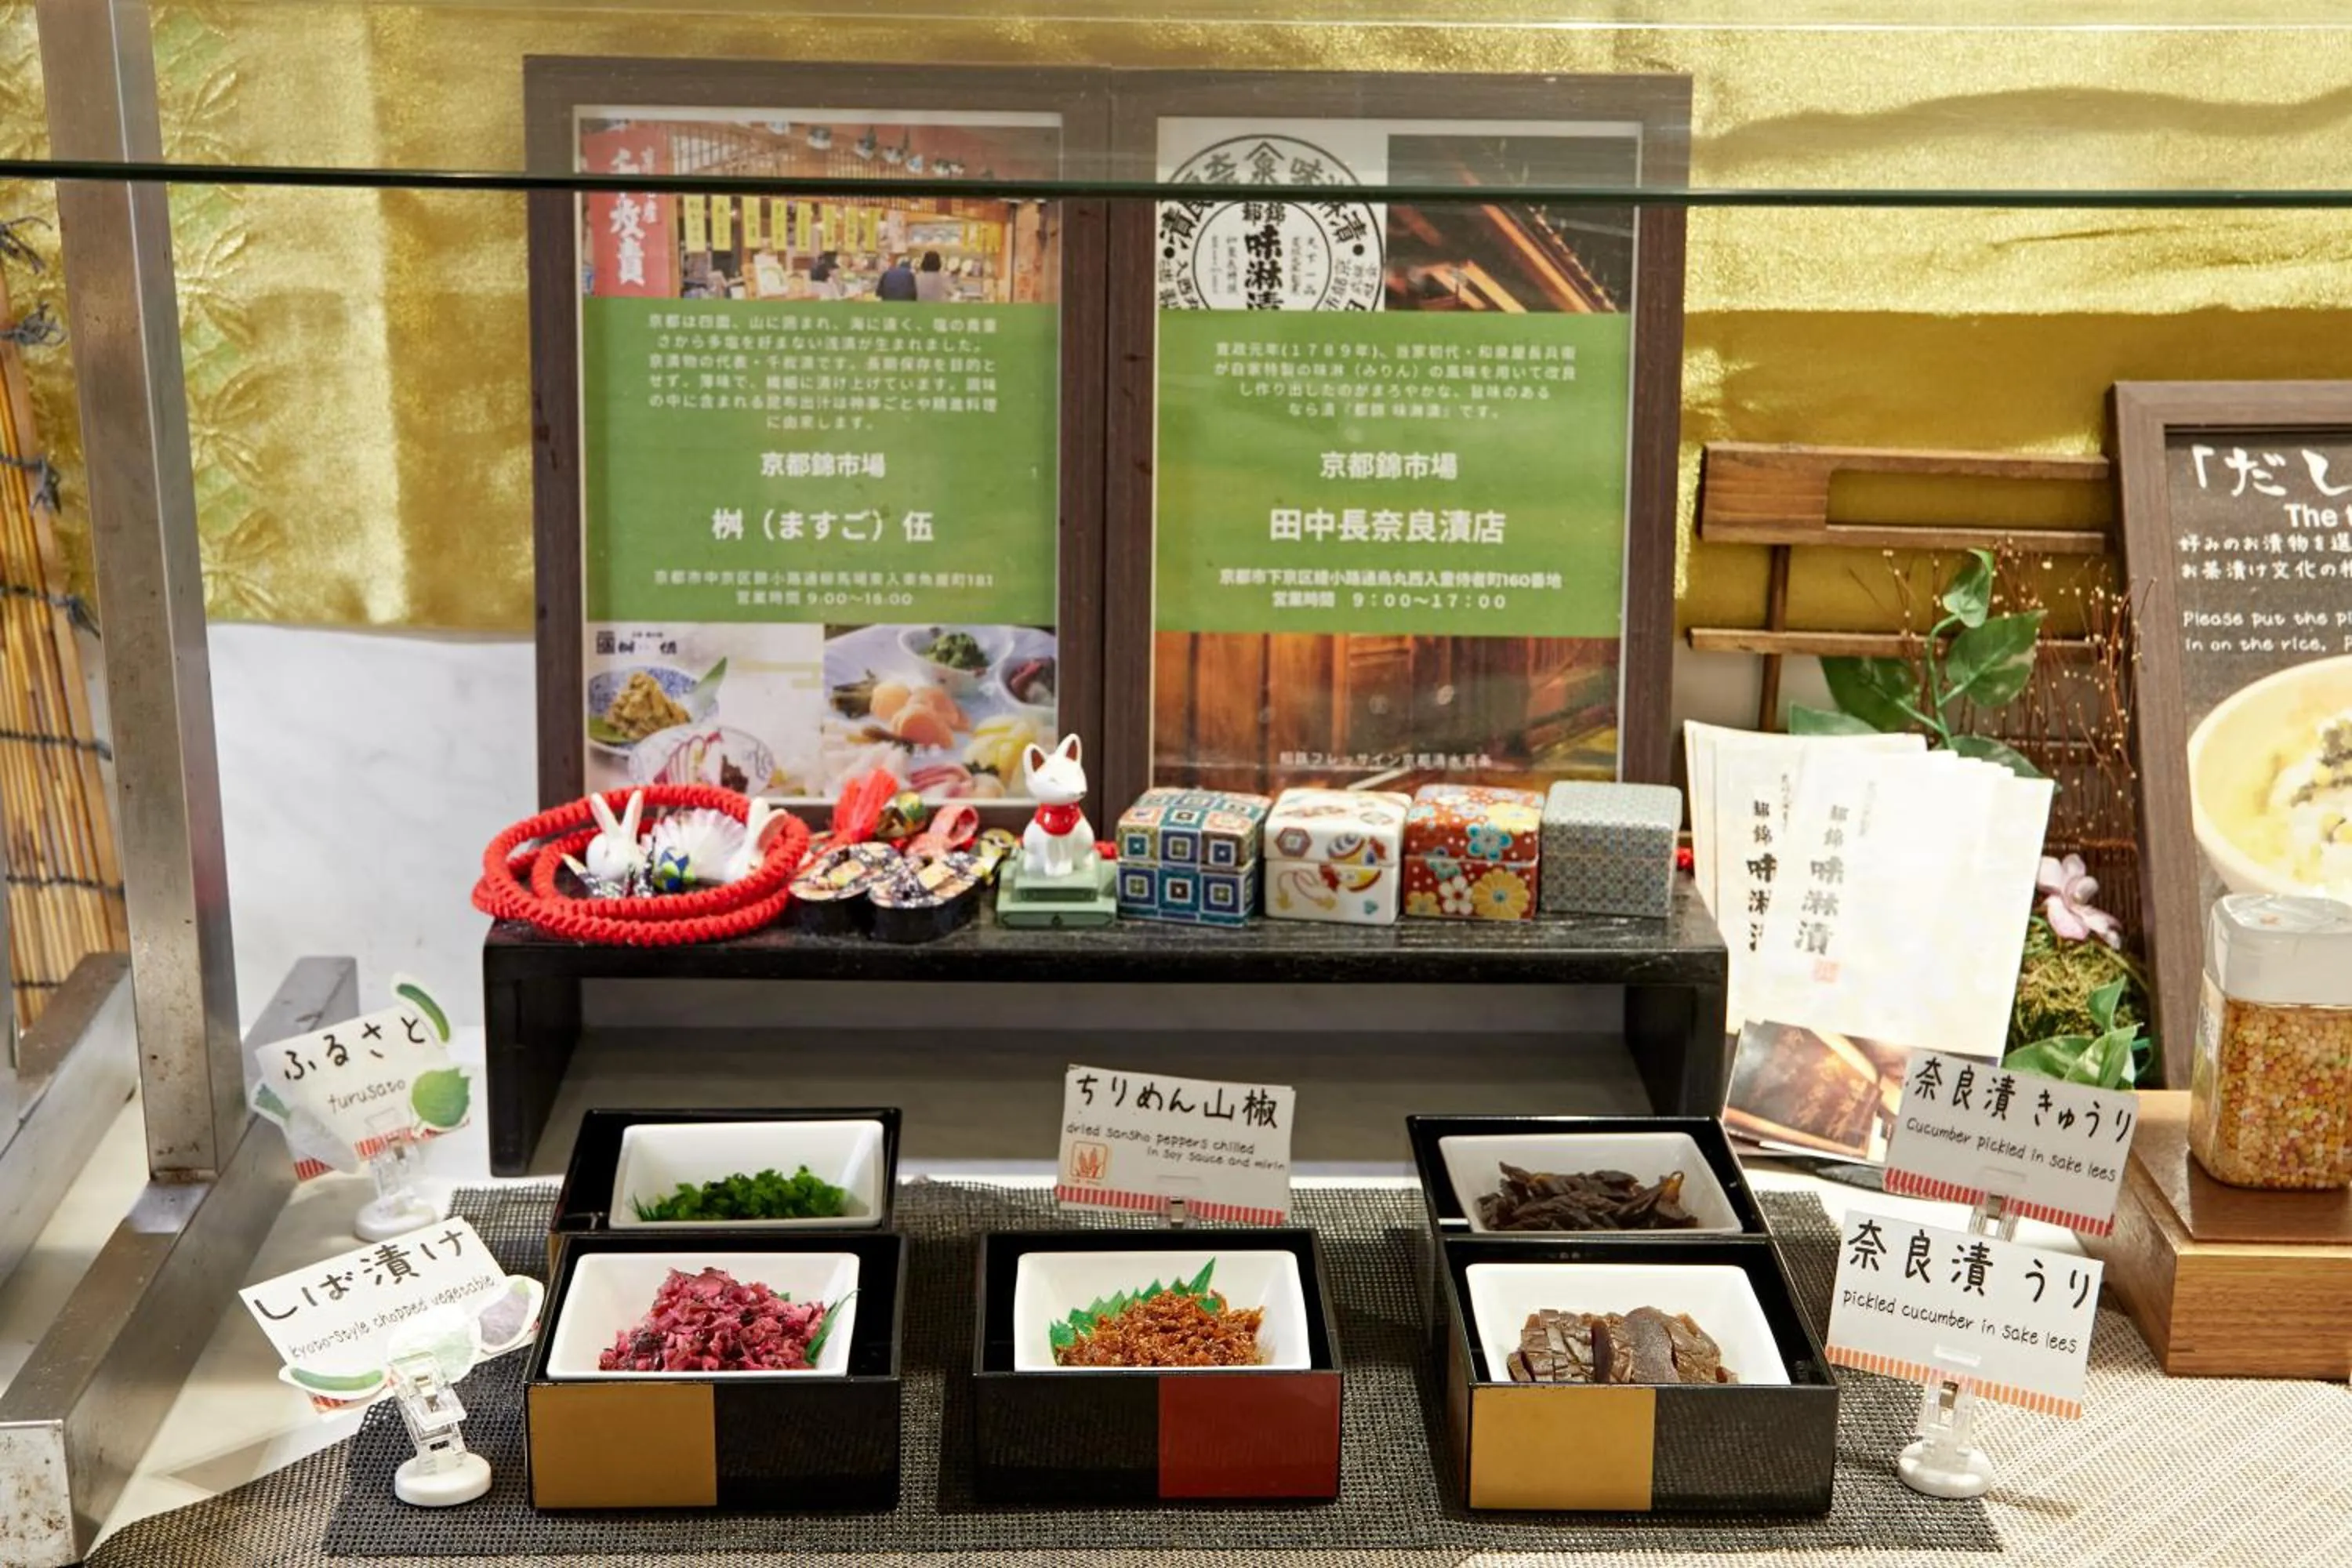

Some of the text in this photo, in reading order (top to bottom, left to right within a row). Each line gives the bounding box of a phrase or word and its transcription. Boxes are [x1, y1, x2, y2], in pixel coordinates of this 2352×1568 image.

[760, 451, 886, 478] 京都錦市場
[1320, 452, 1457, 480] 京都錦市場
[1270, 507, 1506, 543] 田中長奈良漬店
[2284, 503, 2337, 528] The
[2183, 611, 2244, 627] Please
[2252, 612, 2285, 628] put
[2293, 611, 2328, 626] the
[2210, 639, 2232, 652] on
[2240, 636, 2274, 652] the
[284, 1016, 426, 1081] ふるさと
[328, 1080, 406, 1114] furusato
[1076, 1074, 1278, 1128] ちりめん山椒
[1914, 1057, 2132, 1142] 奈良漬 きゅうり
[1228, 1157, 1250, 1167] and
[2031, 1148, 2044, 1163] in
[2049, 1154, 2082, 1174] sake
[2087, 1161, 2117, 1181] lees
[254, 1229, 465, 1320] しば漬け
[1847, 1219, 2090, 1308] 奈良漬 うり
[1901, 1305, 1974, 1330] cucumber
[1981, 1319, 1995, 1335] in
[2002, 1324, 2038, 1345] sake
[2045, 1331, 2078, 1354] lees
